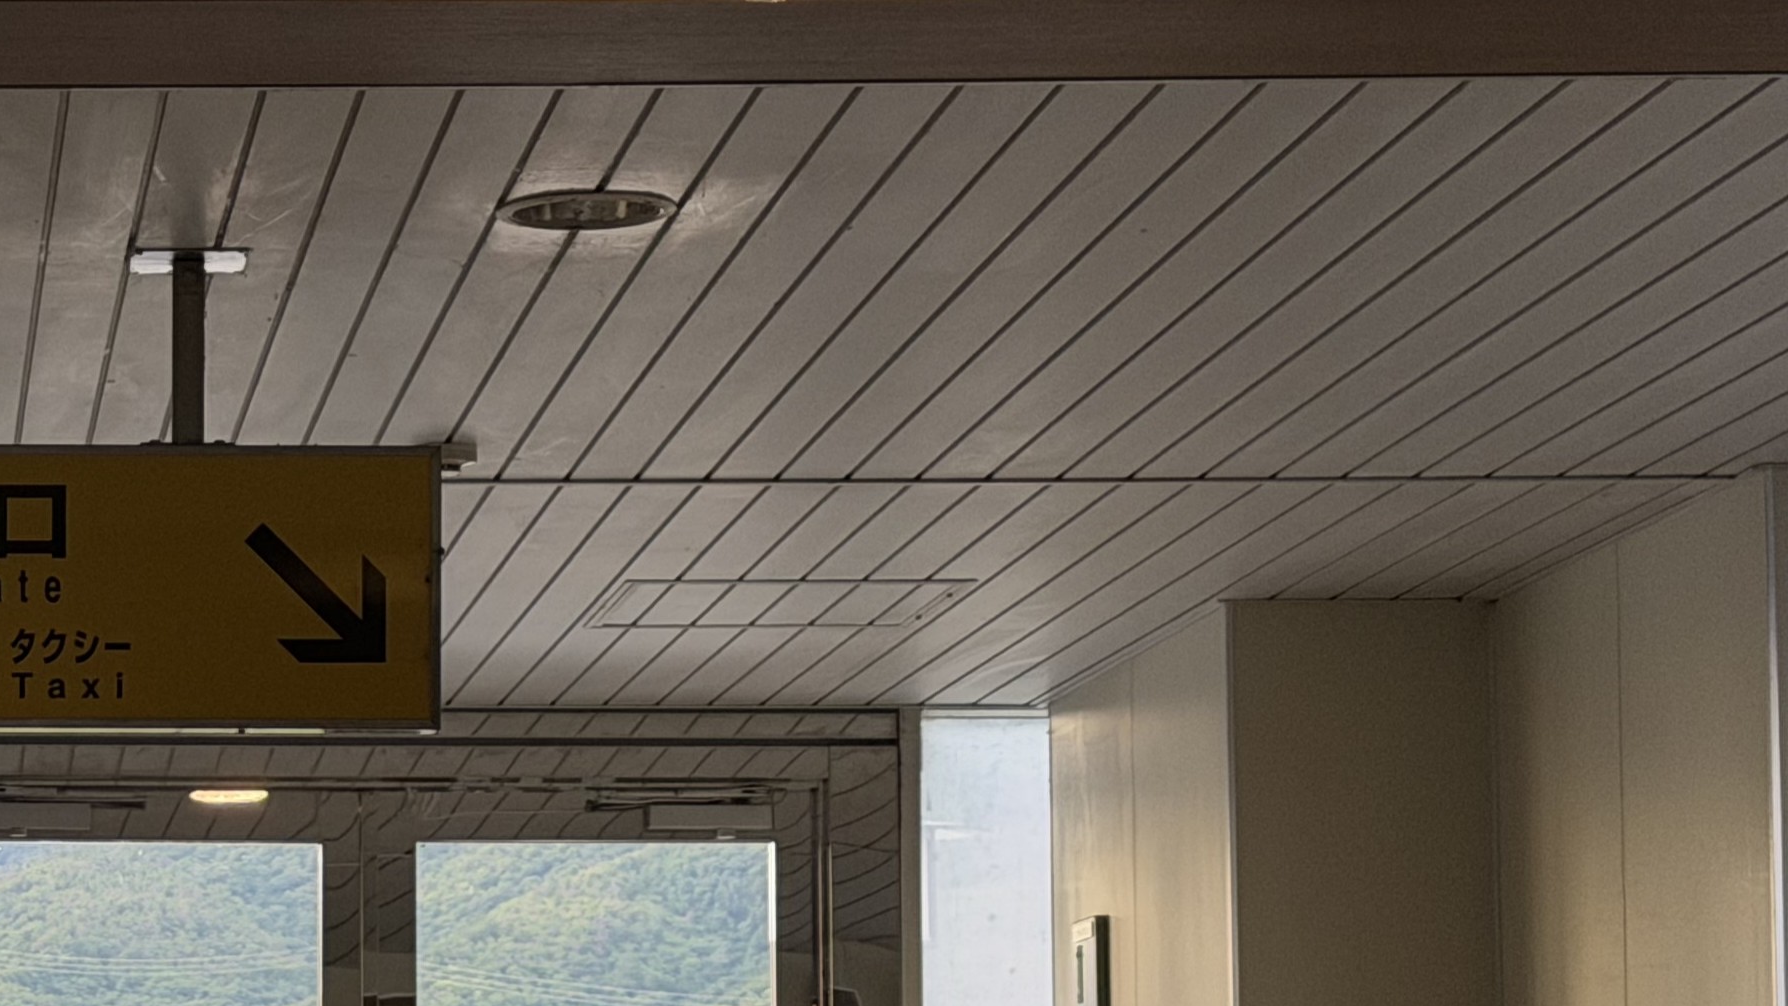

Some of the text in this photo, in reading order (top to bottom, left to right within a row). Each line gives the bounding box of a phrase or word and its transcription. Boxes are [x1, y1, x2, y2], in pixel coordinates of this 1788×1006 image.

[9, 628, 132, 665] タクシー
[11, 671, 125, 699] Taxi
